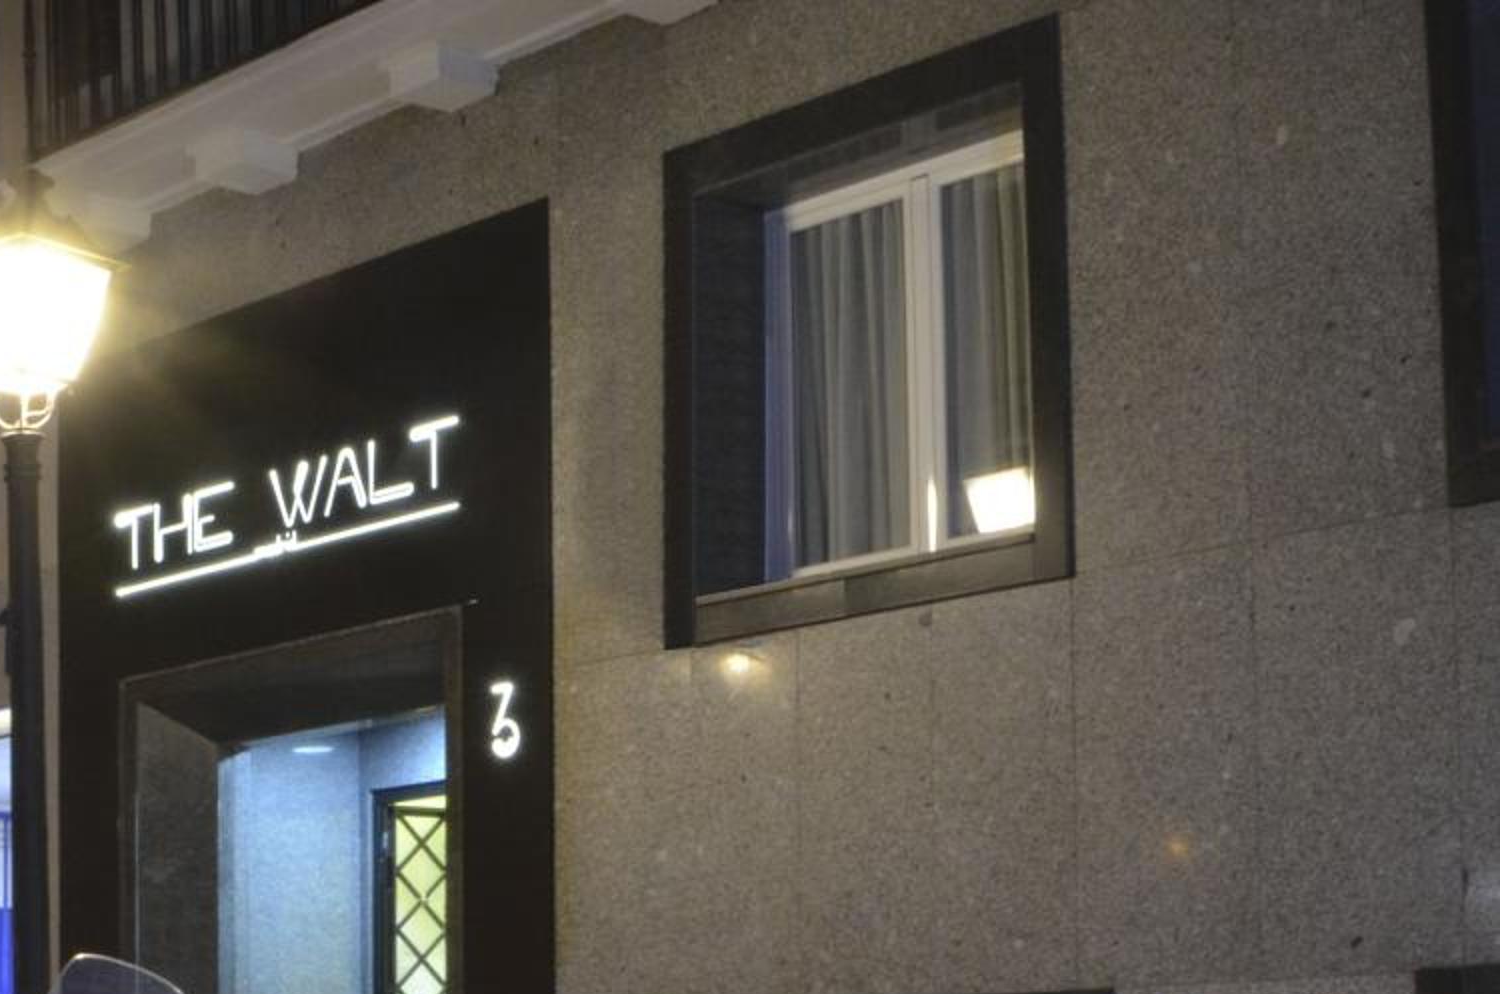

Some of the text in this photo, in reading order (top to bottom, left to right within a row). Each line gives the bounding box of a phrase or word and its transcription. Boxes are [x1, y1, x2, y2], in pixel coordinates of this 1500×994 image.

[114, 414, 460, 569] THE WALT
[491, 681, 521, 759] 3
